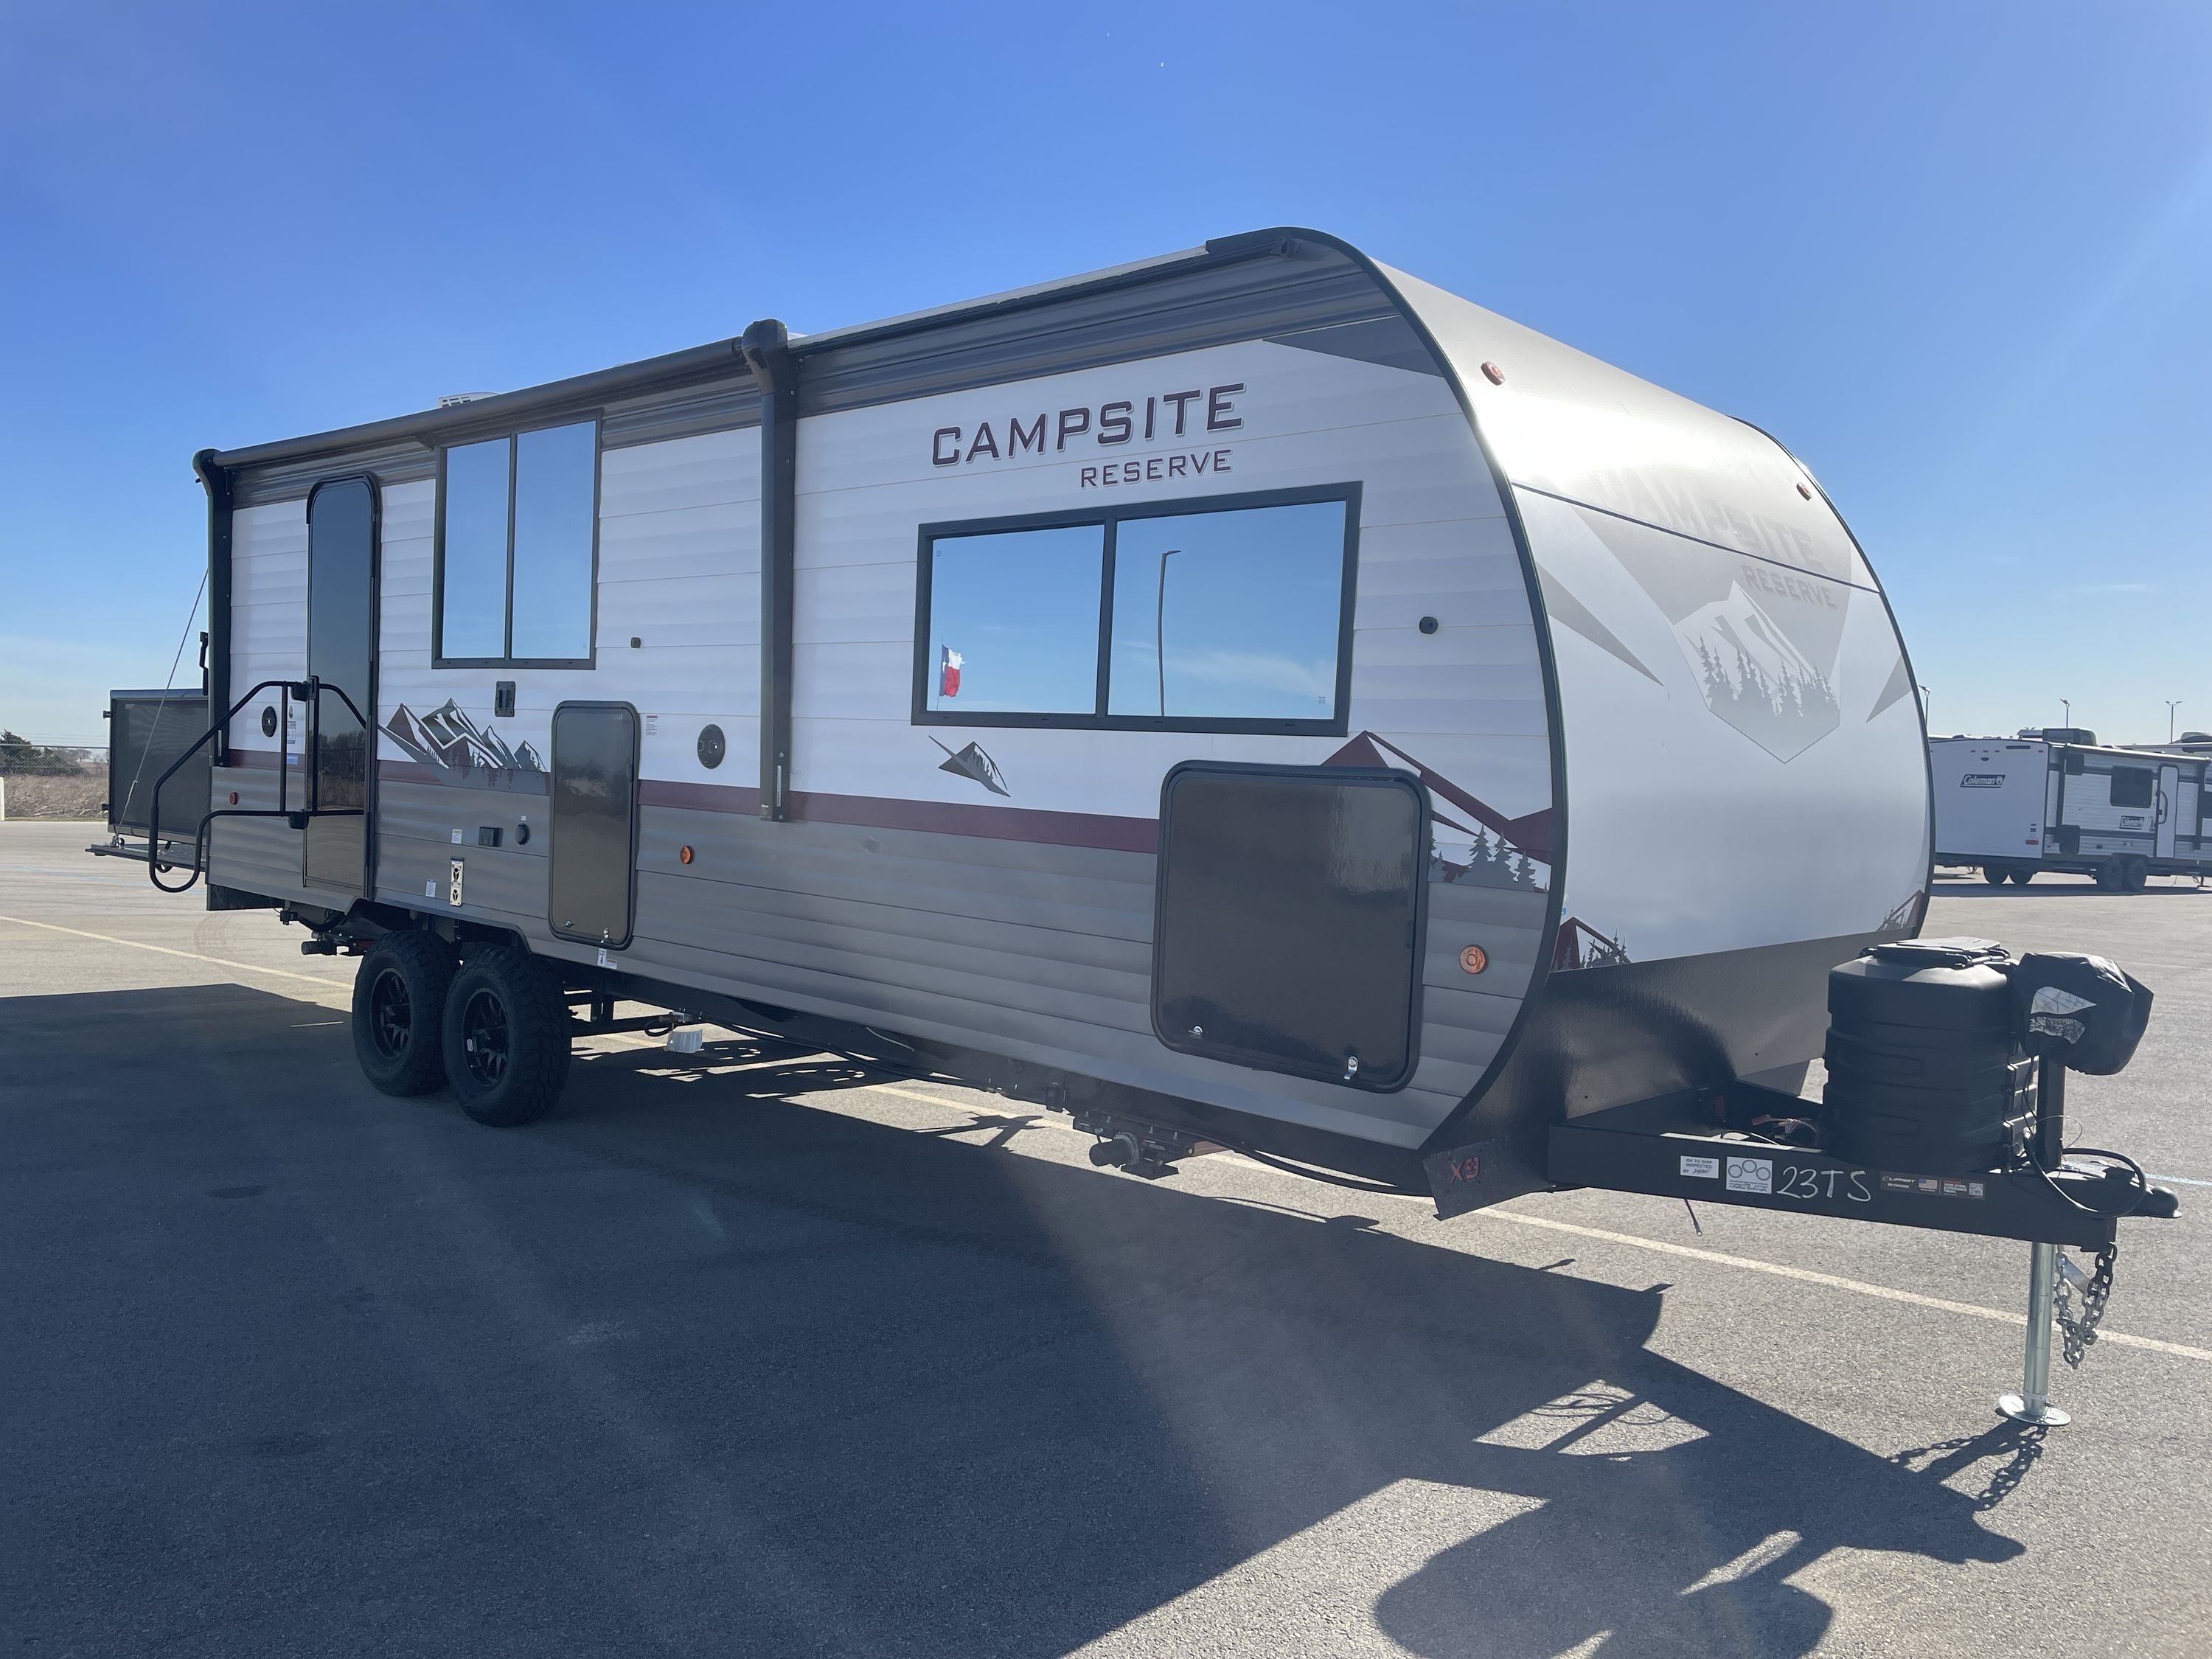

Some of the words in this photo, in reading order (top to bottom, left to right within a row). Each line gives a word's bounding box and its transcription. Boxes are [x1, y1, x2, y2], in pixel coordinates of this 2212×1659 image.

[932, 383, 1246, 467] CAMPSITE
[1080, 448, 1233, 488] RESERVE
[1741, 564, 1838, 609] RESERVE
[1963, 774, 1996, 785] Coleman
[1776, 1166, 1871, 1202] 23TS
